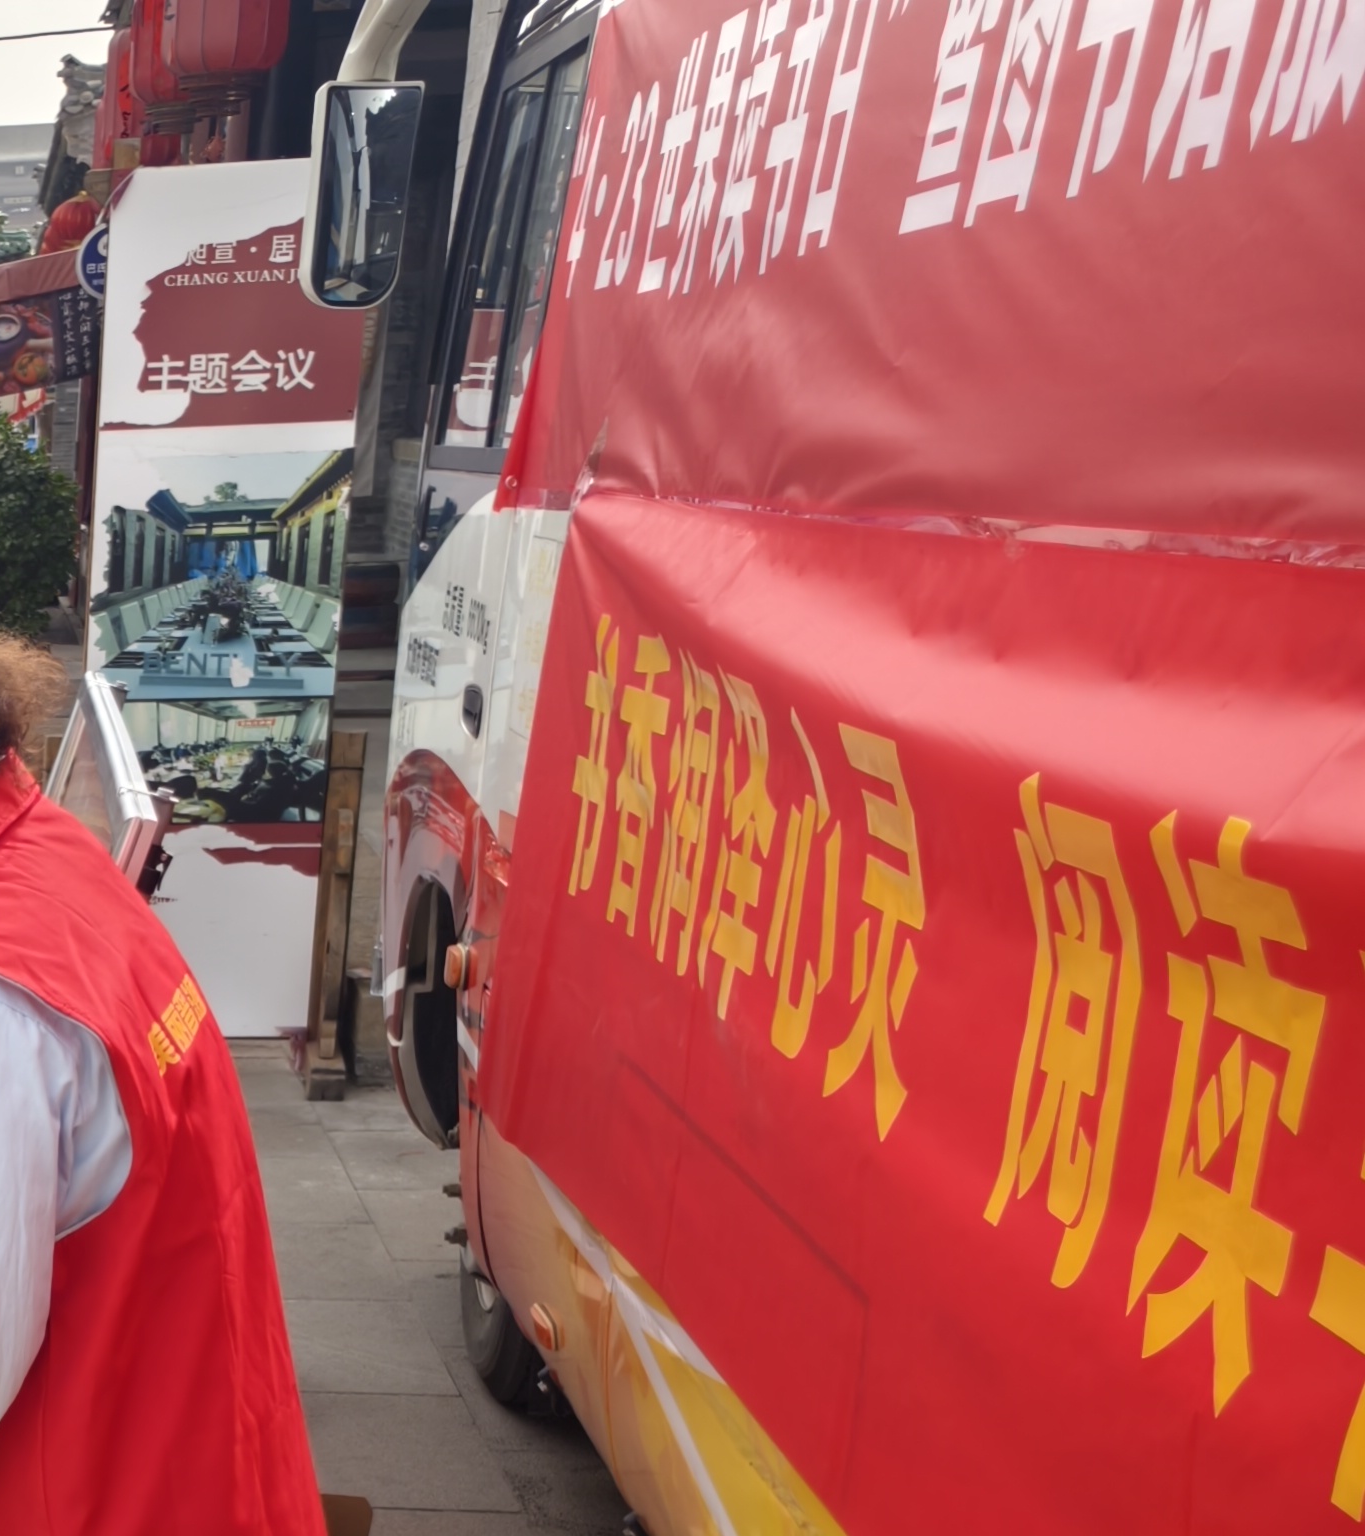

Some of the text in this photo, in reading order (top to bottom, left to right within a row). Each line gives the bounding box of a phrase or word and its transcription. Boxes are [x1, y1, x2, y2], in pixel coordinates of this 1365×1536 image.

[164, 271, 228, 287] CHANG
[233, 268, 285, 284] XUAN
[146, 348, 316, 394] 主题会议
[142, 651, 303, 678] BENTEY
[568, 614, 1365, 1522] 书香润泽心灵 阅读
